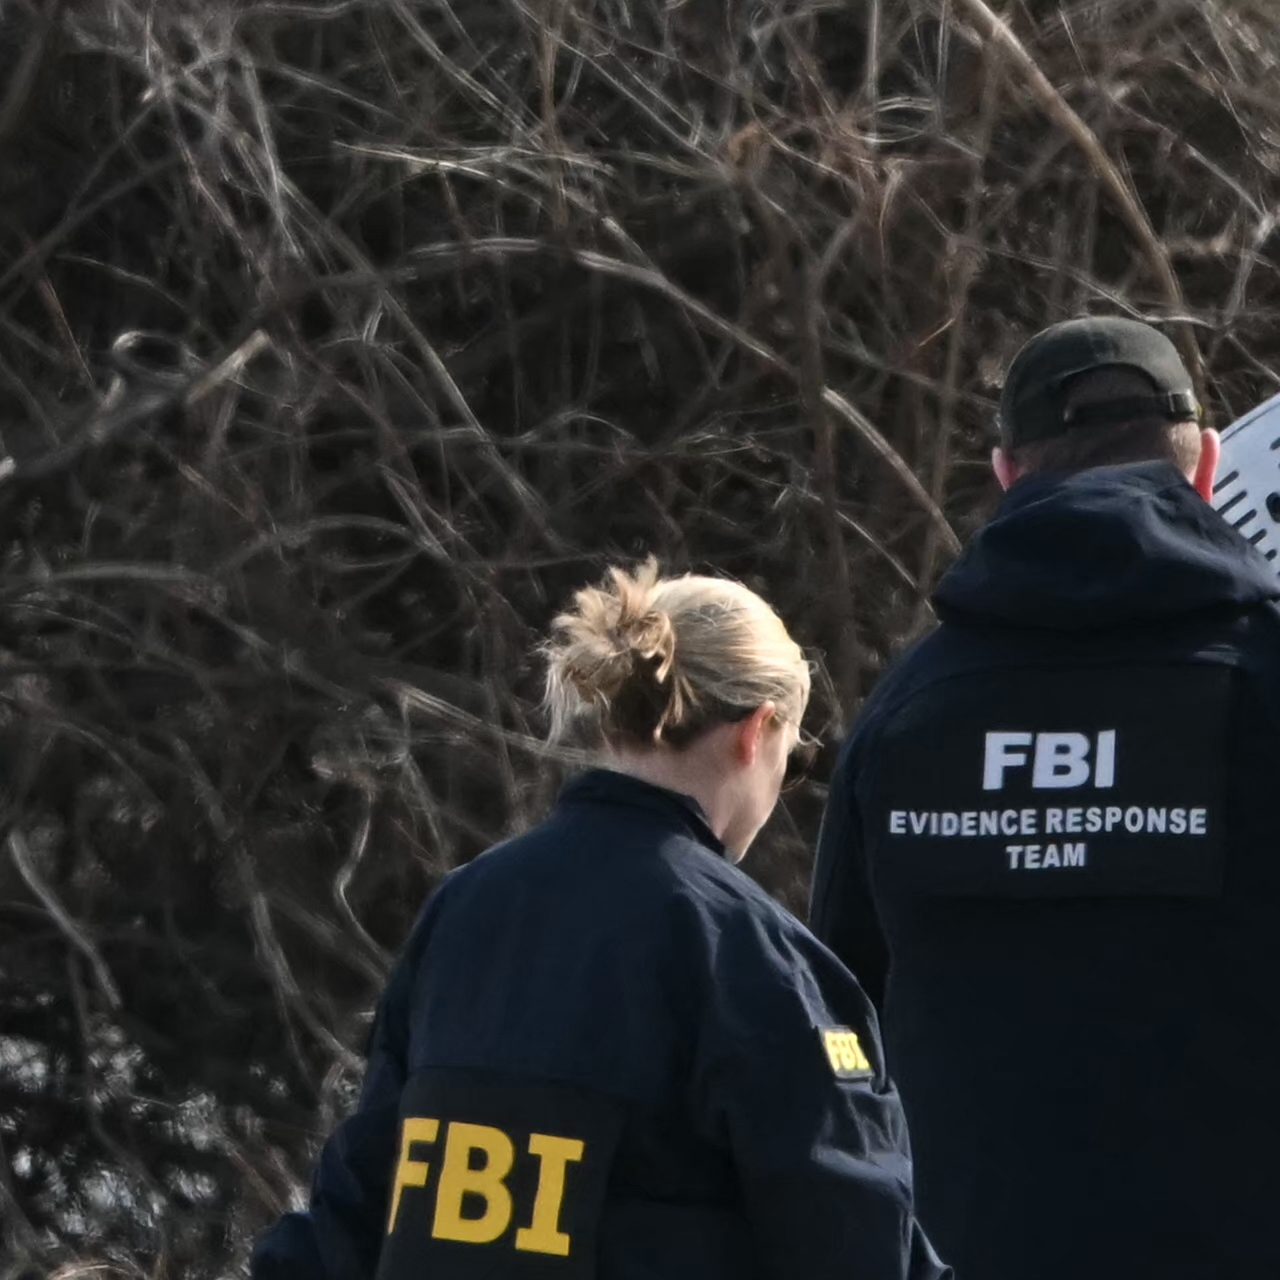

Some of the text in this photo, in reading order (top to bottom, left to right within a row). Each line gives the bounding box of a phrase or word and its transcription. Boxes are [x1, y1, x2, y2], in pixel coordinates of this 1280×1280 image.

[982, 729, 1116, 790] FBI
[889, 805, 1207, 836] EVIDENCE RESPONSE
[1006, 842, 1087, 870] TEAM
[824, 1031, 871, 1071] FBI
[386, 1117, 585, 1256] FBI
